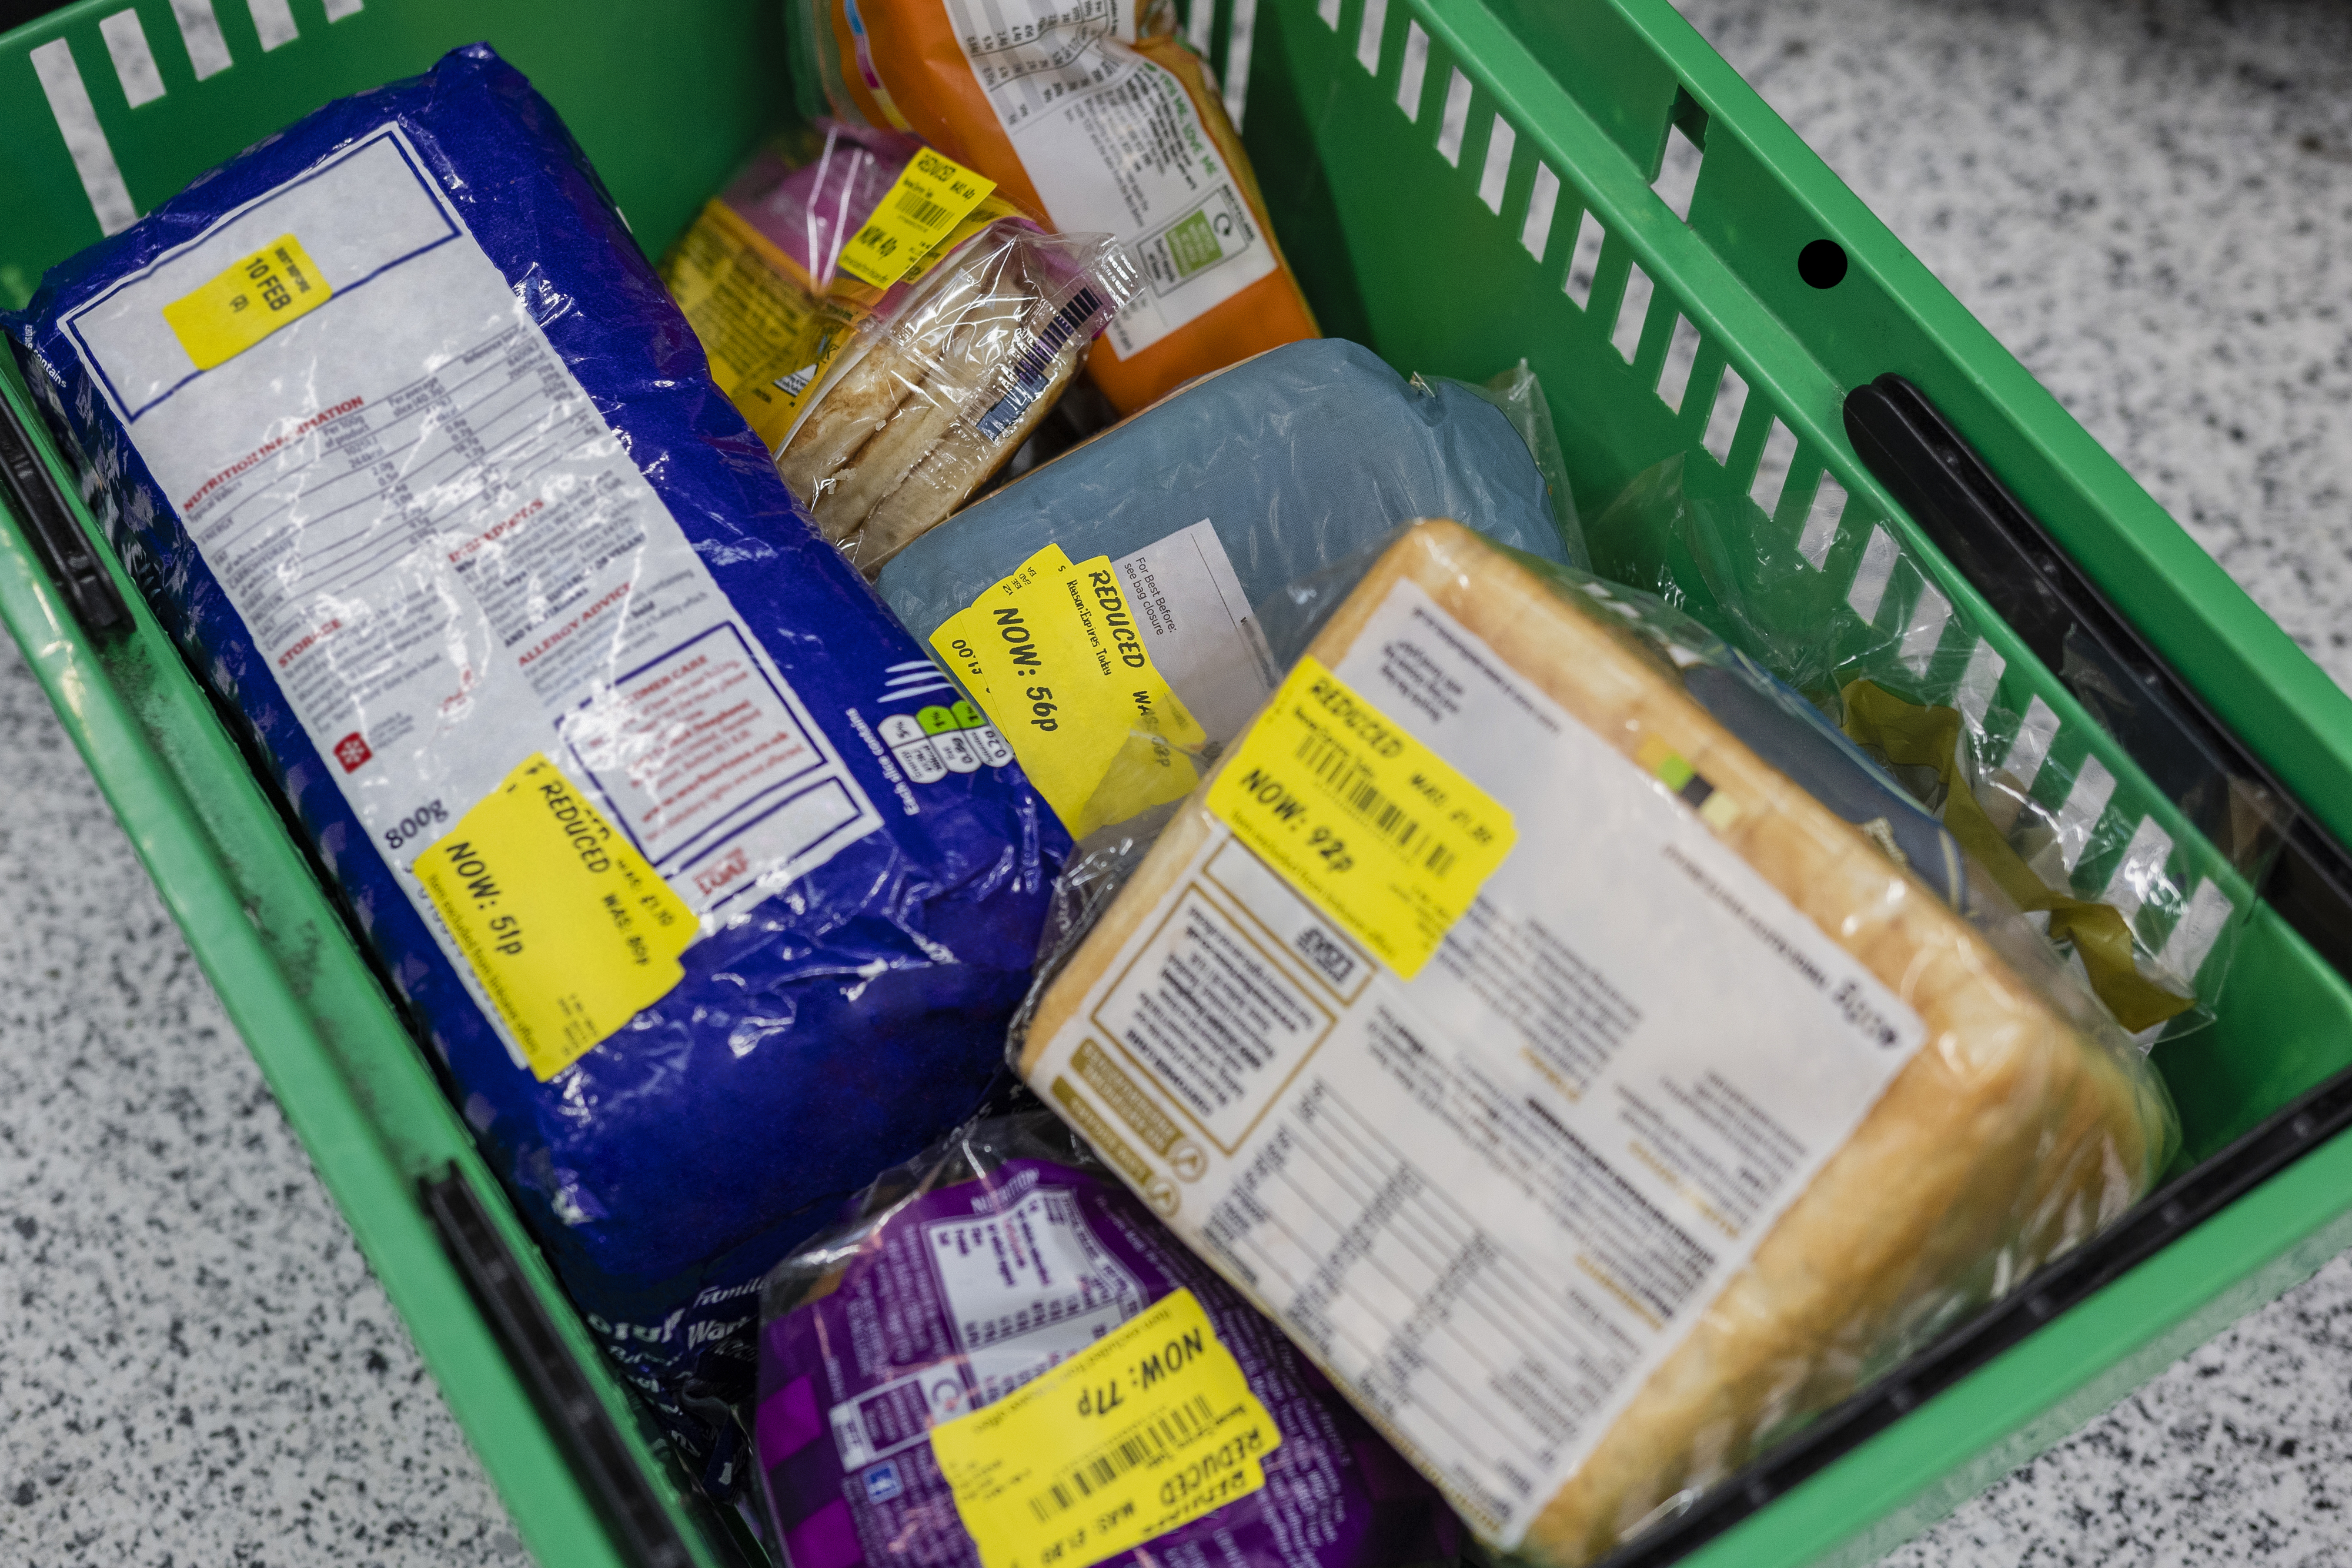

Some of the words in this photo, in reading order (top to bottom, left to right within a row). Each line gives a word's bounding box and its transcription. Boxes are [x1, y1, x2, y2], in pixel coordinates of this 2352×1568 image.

[243, 255, 270, 281] 10
[256, 273, 292, 313] FEB
[181, 450, 261, 512] NUTRITION
[1063, 579, 1103, 648] Reason:Expires
[1094, 648, 1115, 677] Today
[1085, 566, 1148, 672] REDUCED
[1122, 562, 1137, 580] see
[1130, 579, 1148, 601] bag
[1141, 599, 1166, 636] closure
[1134, 556, 1150, 575] For
[1142, 573, 1162, 598] Best
[1154, 596, 1179, 634] Before:
[515, 617, 582, 667] ALLERGY
[990, 602, 1041, 681] NOW:
[1021, 680, 1064, 737] 56p
[843, 704, 885, 759] contains
[1303, 674, 1407, 764] REDUCED
[875, 753, 902, 786] slice
[891, 780, 921, 817] Each
[381, 797, 450, 851] 800g
[537, 776, 613, 878] REDUCED
[600, 891, 635, 935] WAS:
[1237, 763, 1313, 834] NOW:
[1300, 819, 1363, 881] 92p
[443, 837, 505, 914] NOW:
[482, 910, 529, 962] 51p
[1122, 1325, 1209, 1392] NOW:
[1070, 1375, 1127, 1424] 77p
[1151, 1427, 1268, 1508] REDUCED
